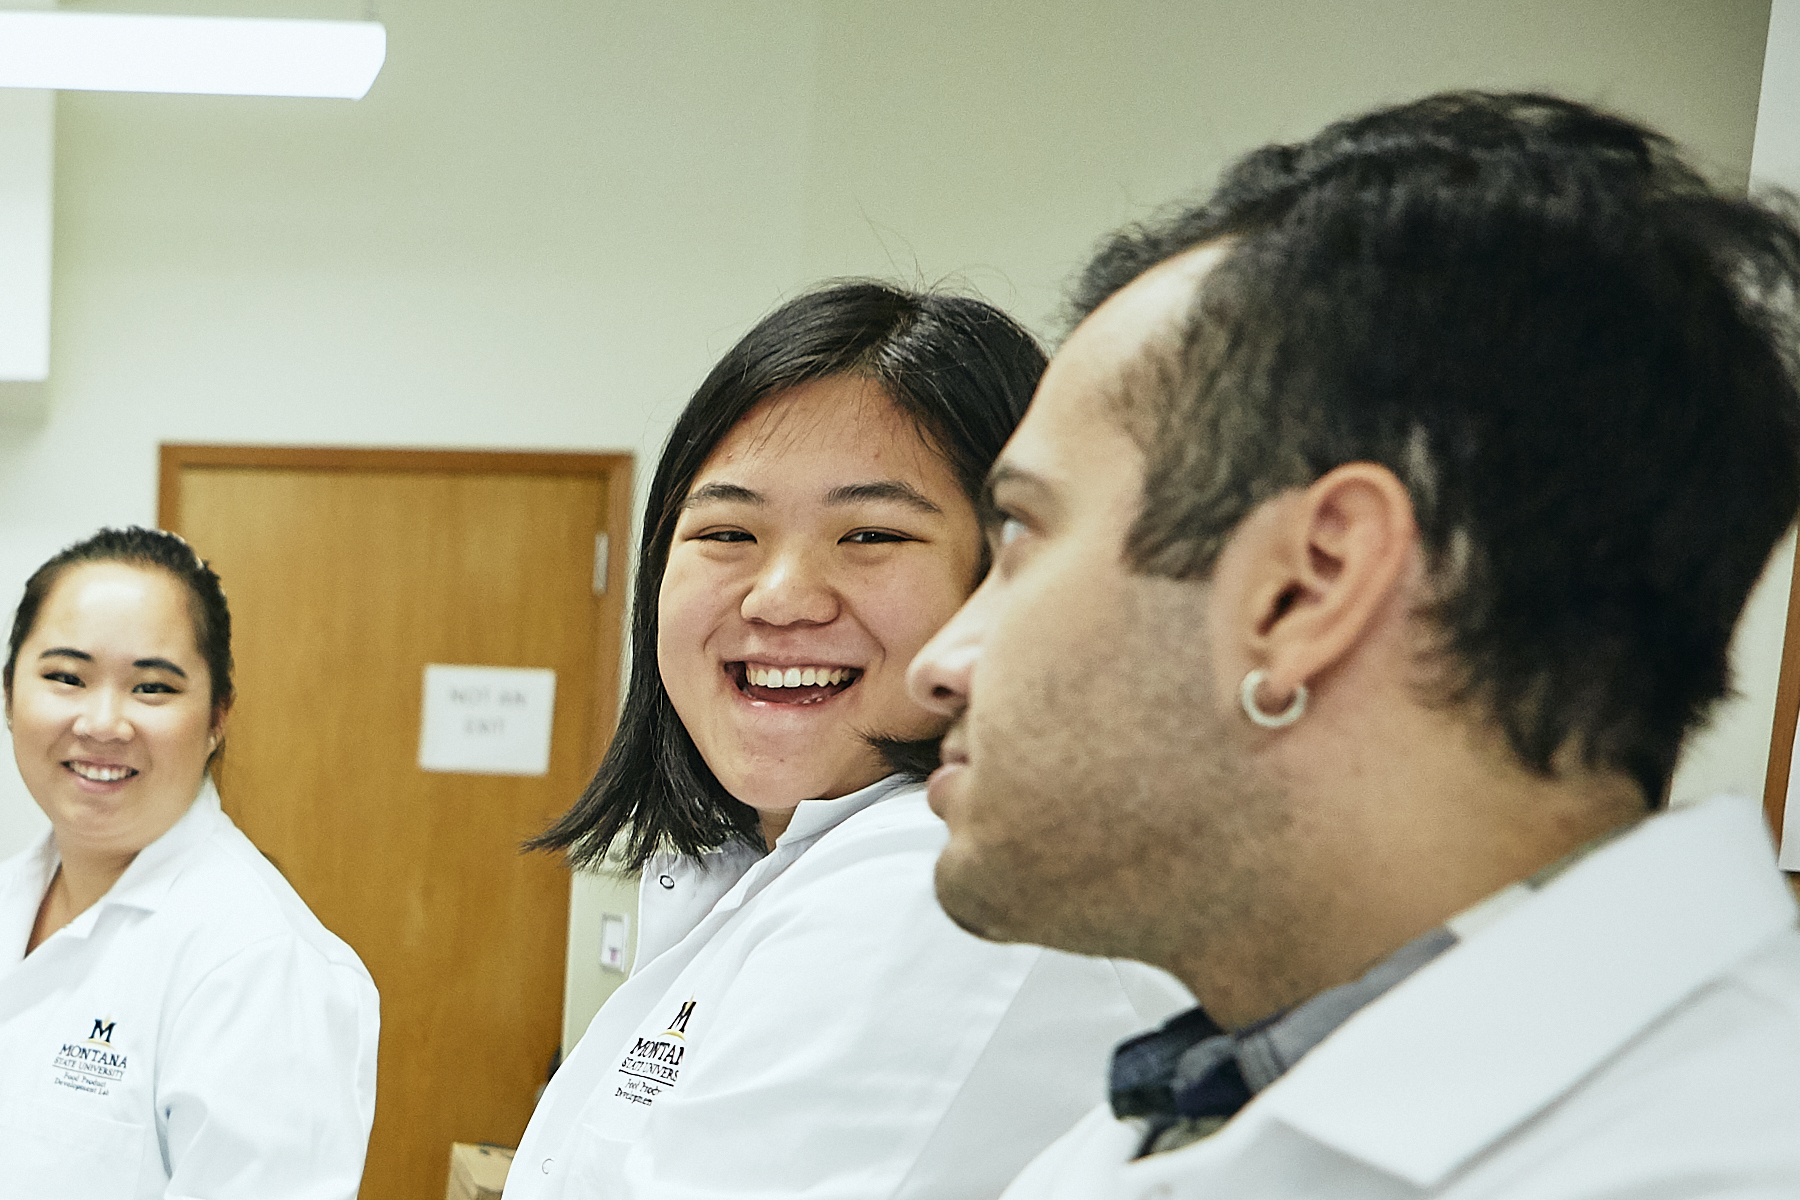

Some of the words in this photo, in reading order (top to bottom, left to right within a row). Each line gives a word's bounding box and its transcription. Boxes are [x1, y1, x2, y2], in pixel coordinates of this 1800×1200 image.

[667, 1001, 697, 1034] M
[88, 1018, 117, 1043] M
[53, 1056, 77, 1068] STATE
[78, 1061, 125, 1079] UNIVERSITY
[59, 1043, 128, 1069] MONTANA
